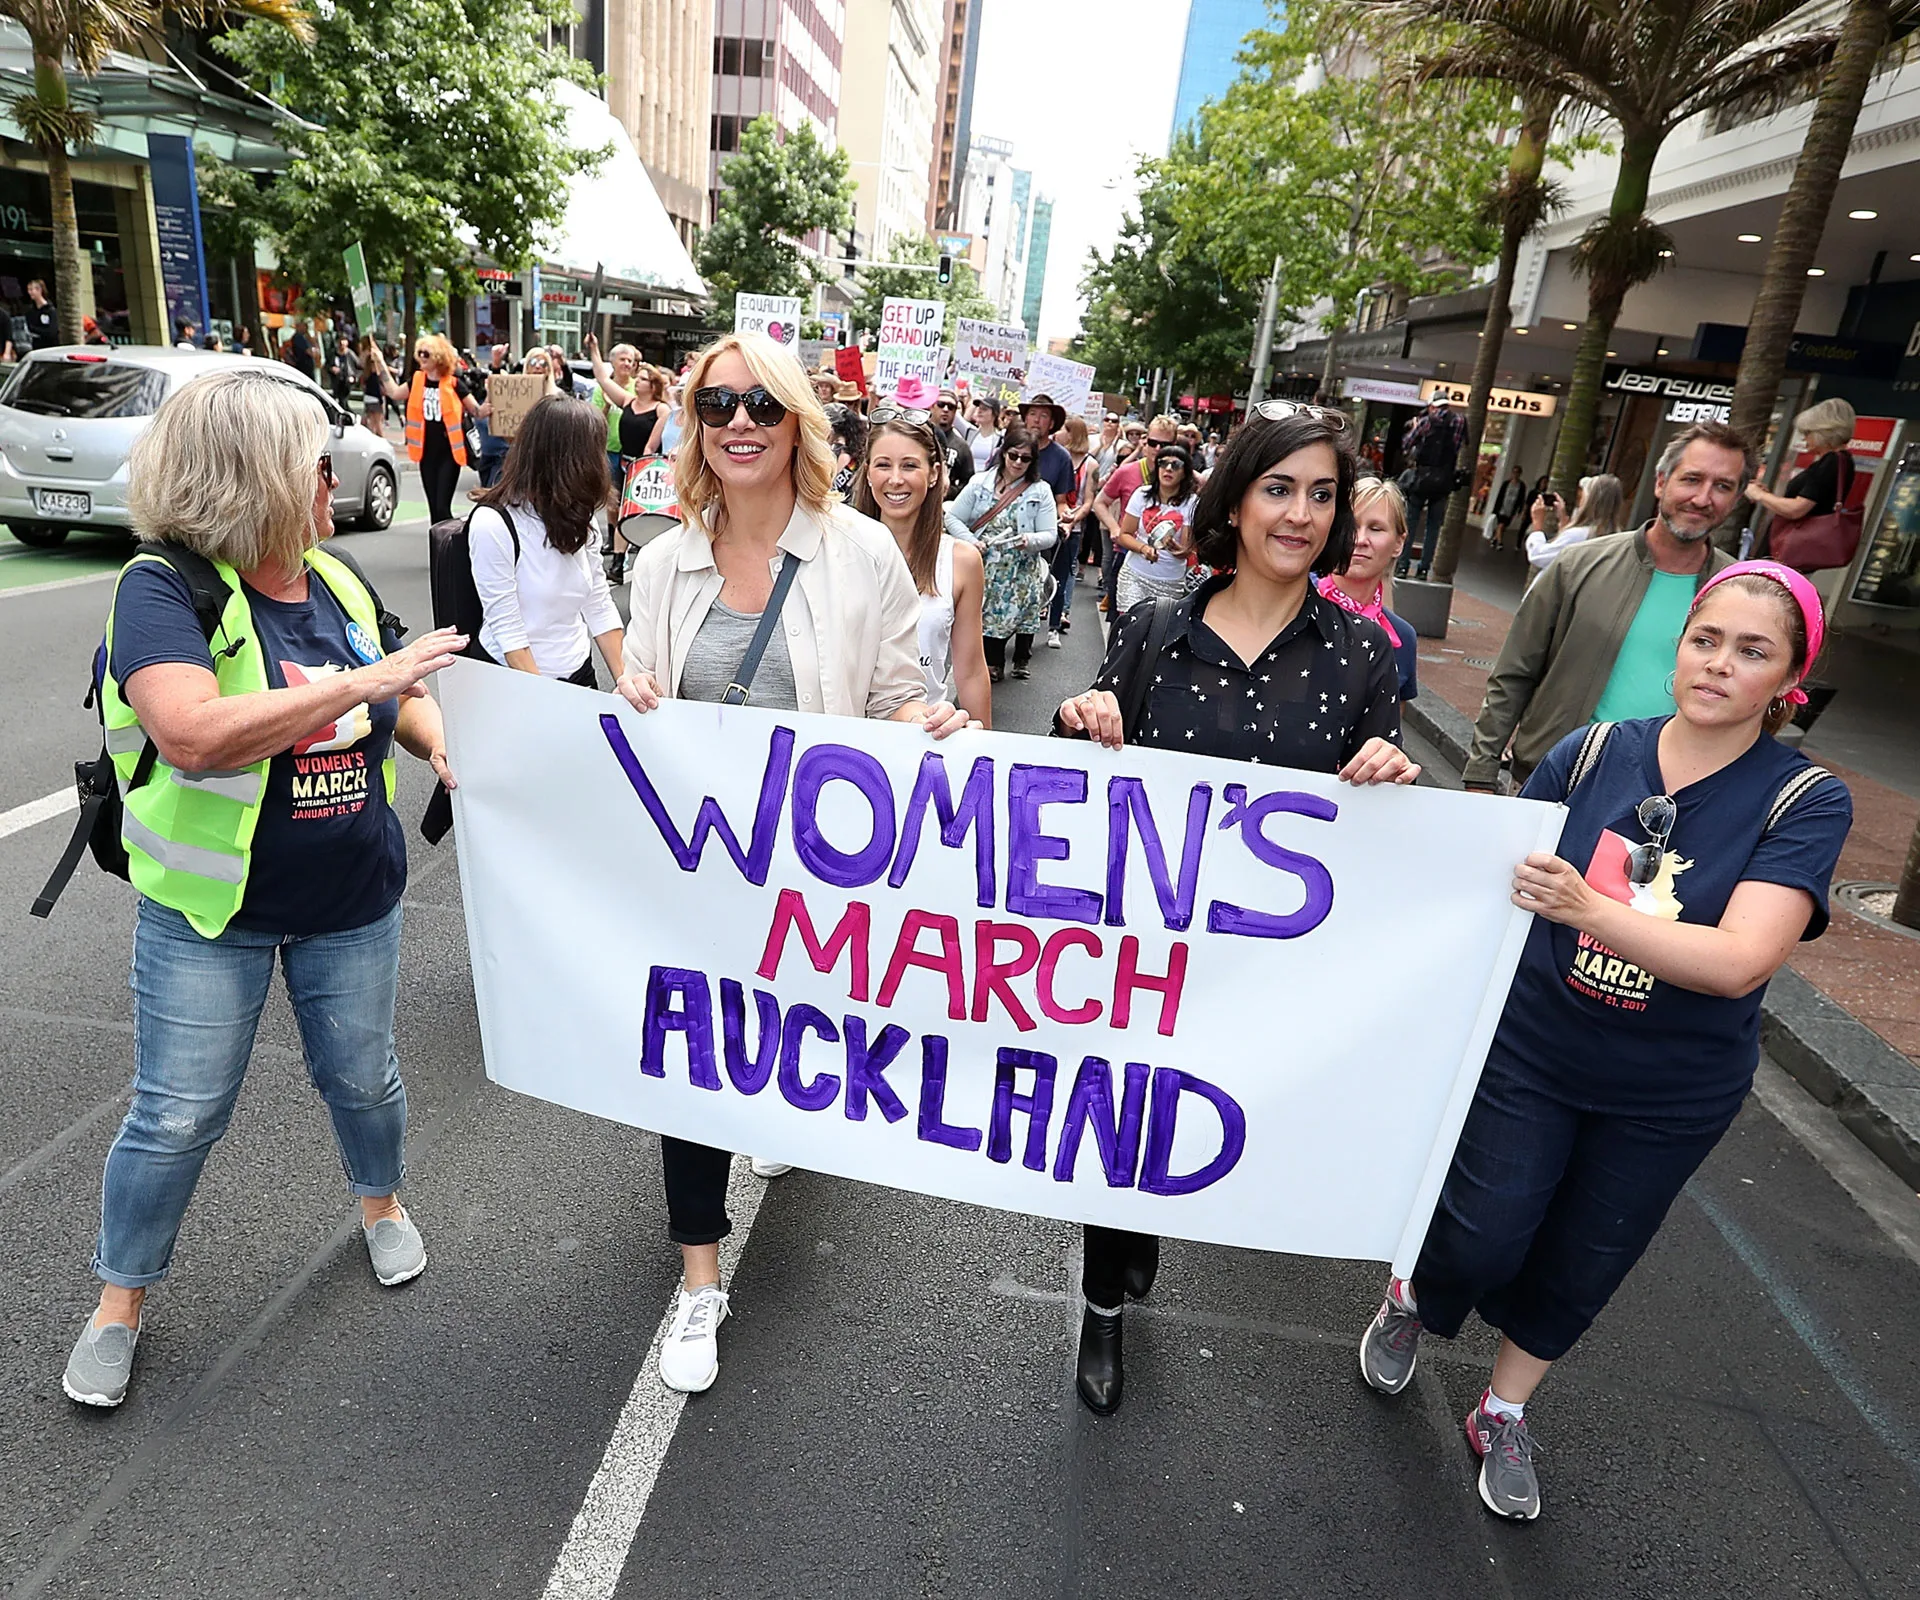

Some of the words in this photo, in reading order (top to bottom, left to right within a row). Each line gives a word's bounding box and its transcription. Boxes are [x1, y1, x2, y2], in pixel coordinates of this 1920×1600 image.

[483, 278, 507, 294] CUE
[542, 290, 578, 304] ocker
[740, 296, 798, 314] EQUALITY
[884, 304, 913, 324] GET
[915, 307, 935, 325] UP
[740, 316, 764, 332] FOR
[960, 320, 975, 332] Not
[979, 323, 995, 336] the
[998, 327, 1027, 341] Church
[881, 325, 923, 346] STAND
[923, 329, 940, 348] UP
[926, 350, 937, 362] UP
[970, 345, 1013, 363] WOMEN
[879, 360, 900, 379] THE
[904, 363, 936, 383] FIGHT
[1605, 367, 1735, 403] Jeanswes
[294, 751, 365, 774] WOMEN'S
[292, 768, 368, 799] MARCH
[292, 806, 335, 819] JANUARY
[350, 801, 365, 813] 20
[600, 713, 1338, 939] WOMEN'S
[757, 889, 1187, 1037] MARCH
[1574, 946, 1655, 991] MARCH
[1565, 975, 1603, 1000] JANUARY
[1621, 999, 1648, 1013] 2017
[1598, 983, 1615, 994] NEW
[1615, 988, 1646, 1000] ZEALAND
[640, 965, 1246, 1197] AUCKLAND
